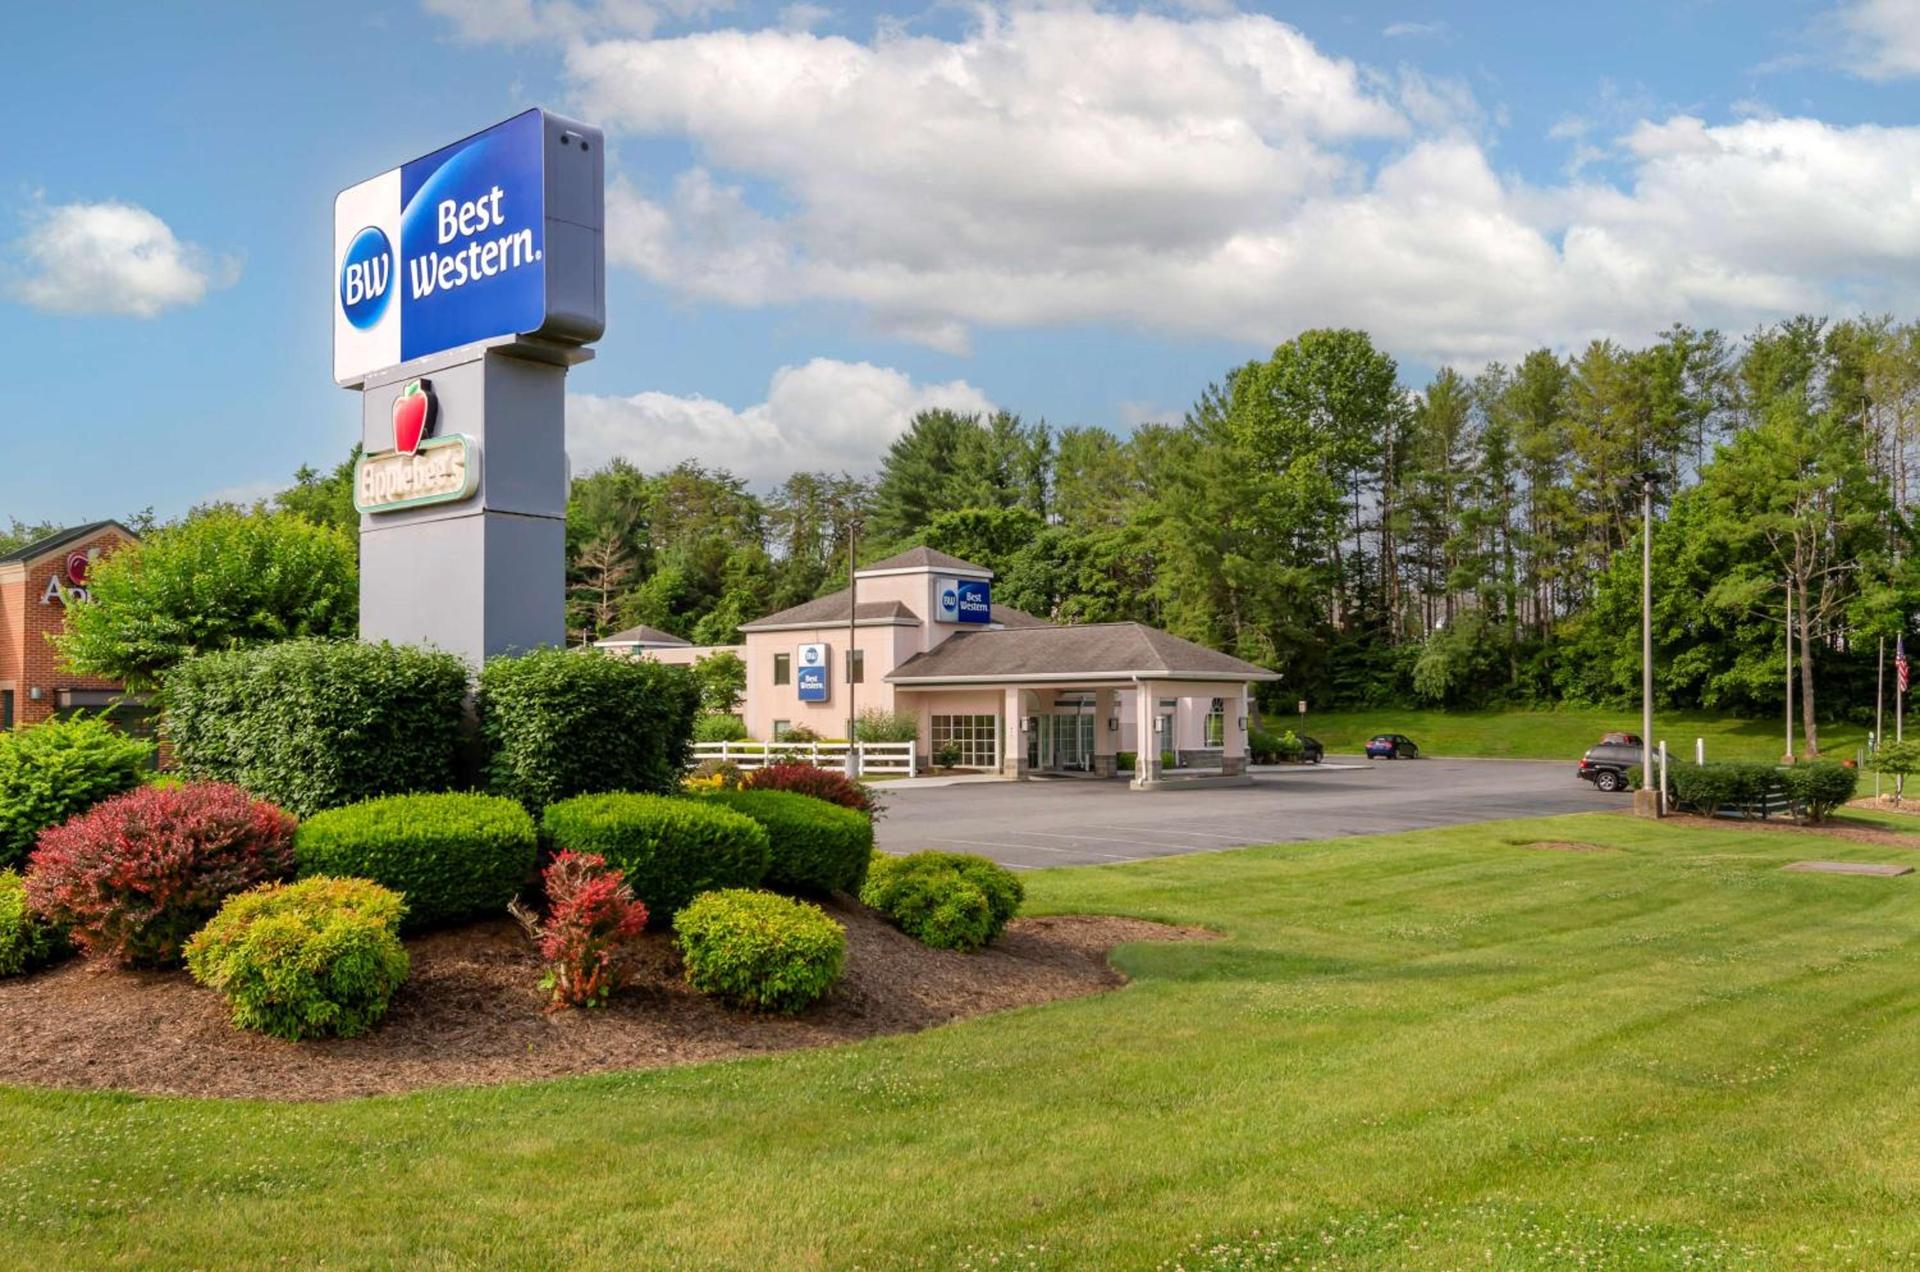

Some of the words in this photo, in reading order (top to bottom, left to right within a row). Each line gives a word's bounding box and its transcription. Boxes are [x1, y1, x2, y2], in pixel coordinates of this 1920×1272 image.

[438, 185, 504, 245] Best
[346, 252, 389, 305] BW
[966, 591, 982, 602] Best
